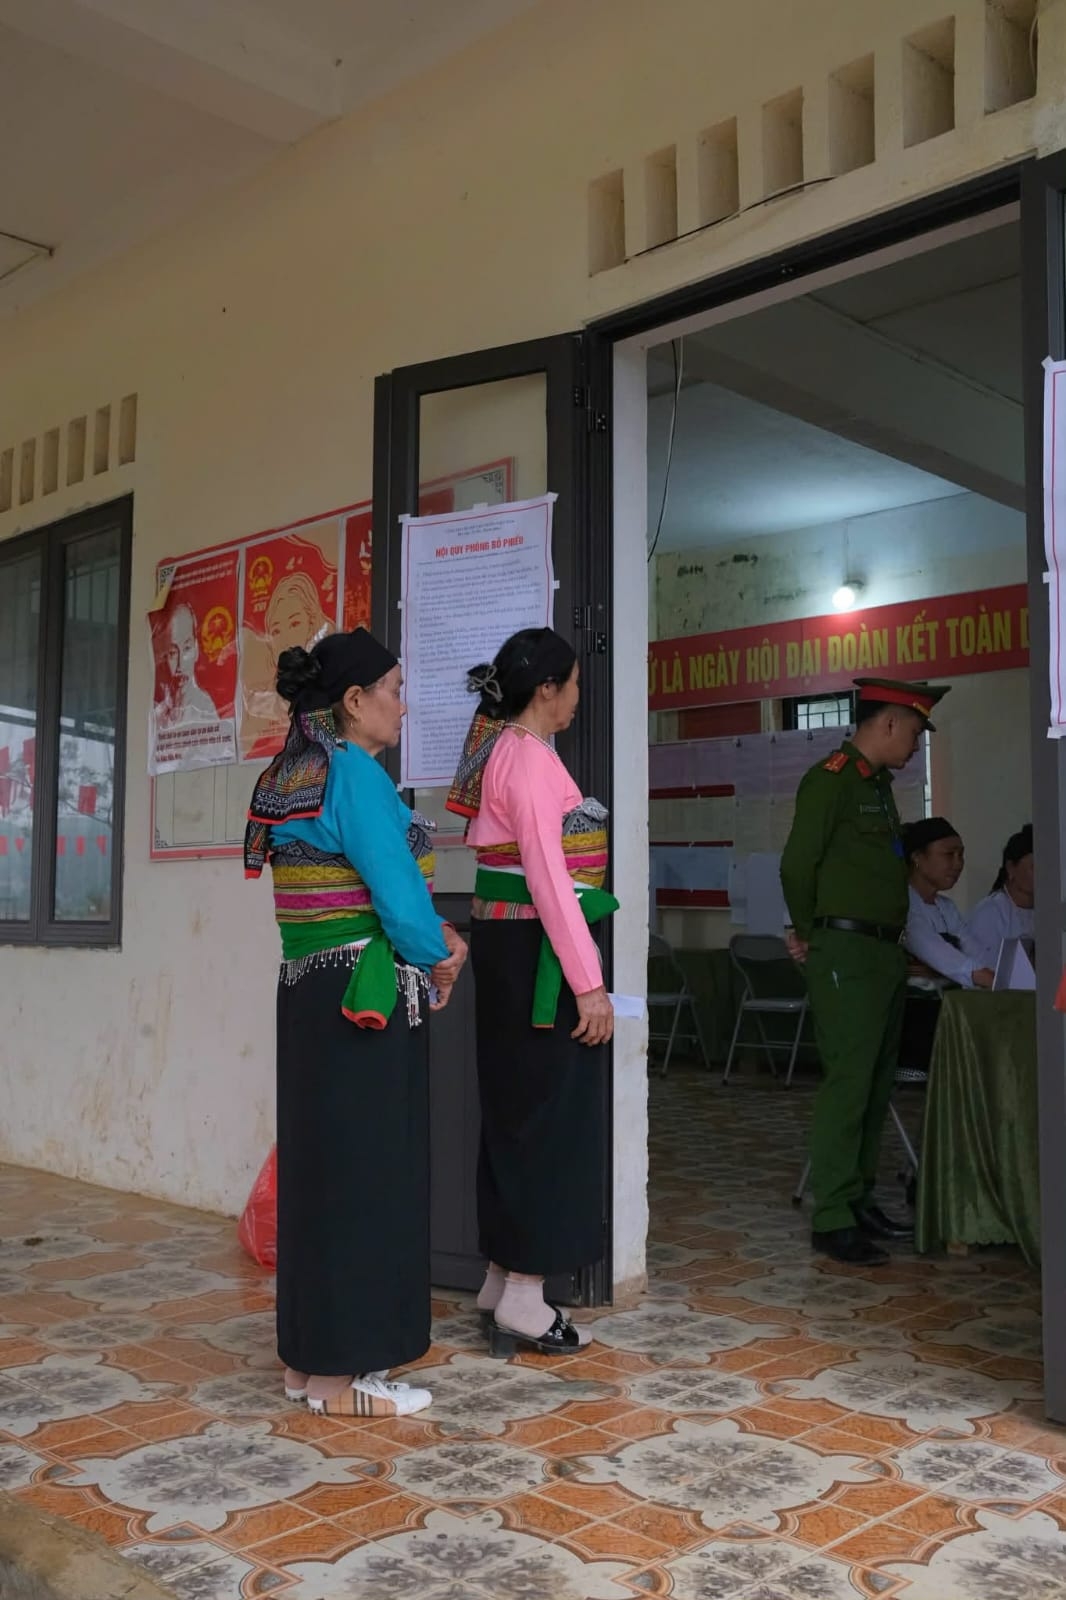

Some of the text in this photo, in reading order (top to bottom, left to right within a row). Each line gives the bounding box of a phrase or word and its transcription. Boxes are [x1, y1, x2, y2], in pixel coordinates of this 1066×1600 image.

[450, 546, 463, 556] QUY
[662, 650, 684, 694] LÀ
[689, 644, 740, 690] NGÀY
[746, 638, 781, 689] HỘI
[786, 637, 822, 686] ĐẠI
[827, 622, 889, 672] ĐOÀN
[896, 609, 939, 664] KẾT
[945, 605, 1012, 658] TOÀN
